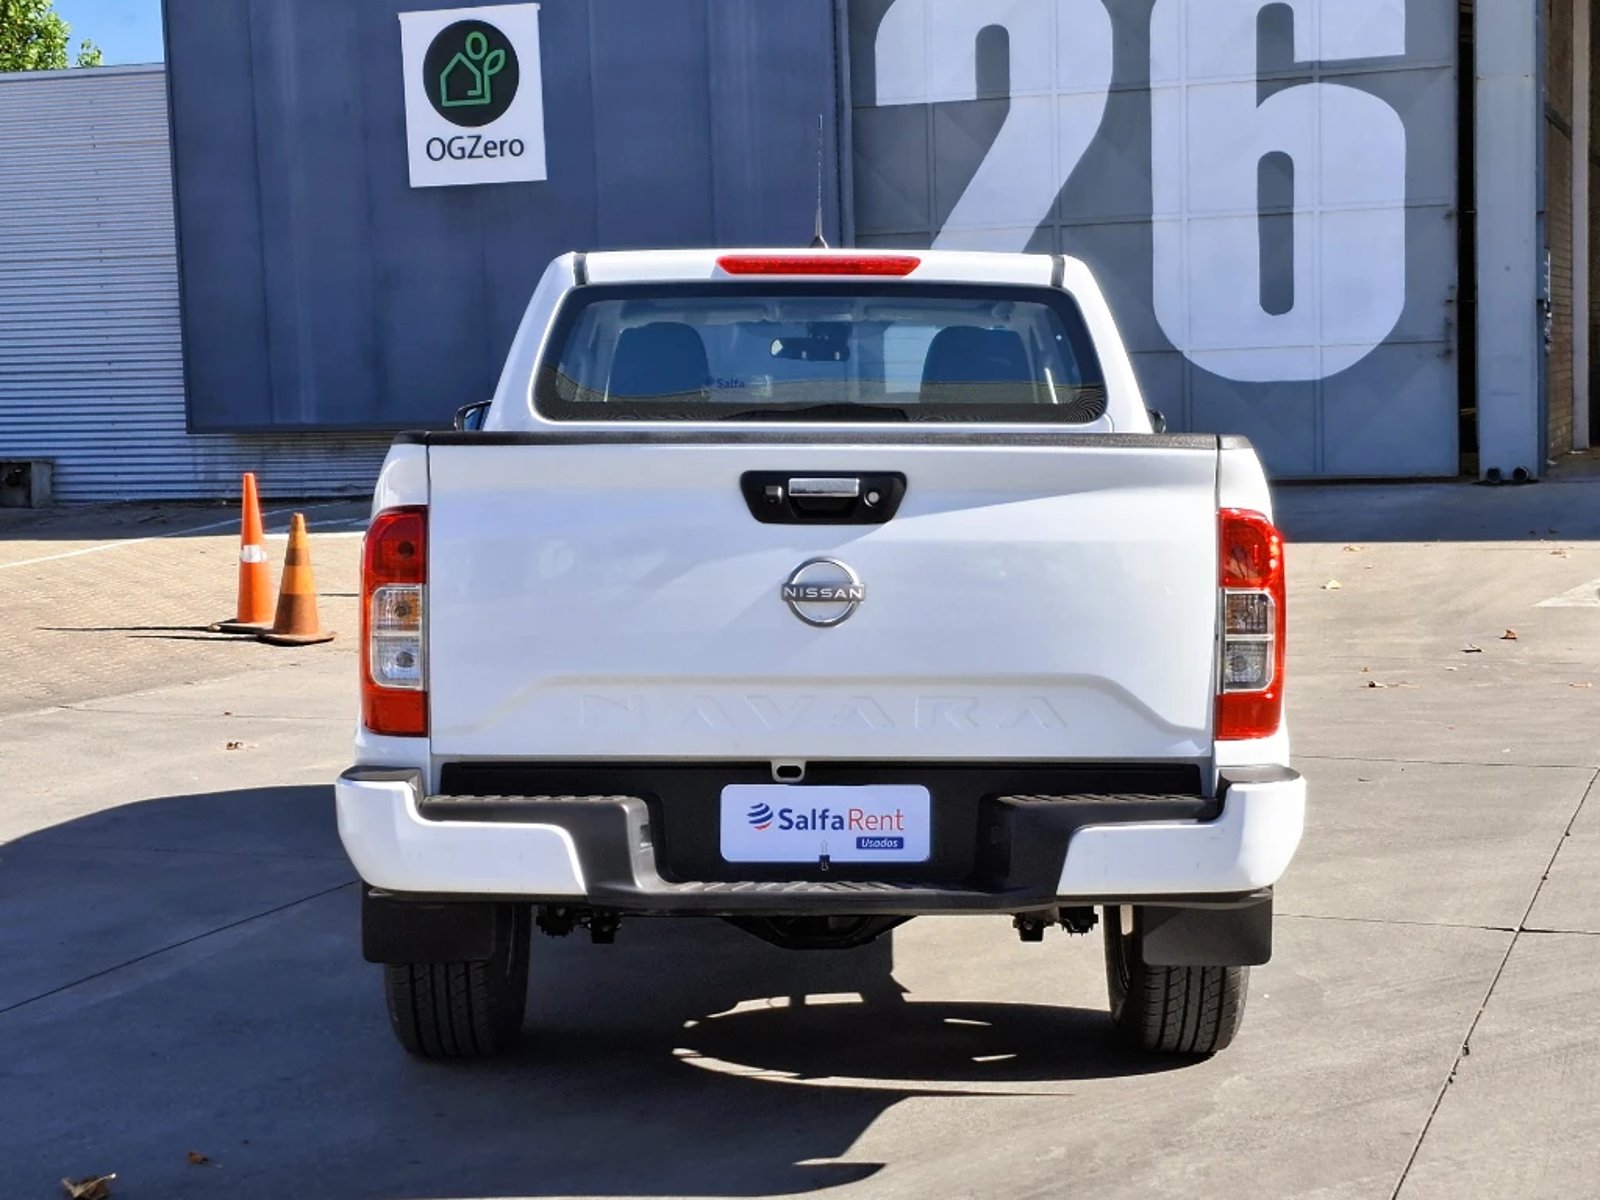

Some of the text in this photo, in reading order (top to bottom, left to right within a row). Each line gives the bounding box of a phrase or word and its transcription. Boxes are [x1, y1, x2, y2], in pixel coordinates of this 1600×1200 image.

[426, 134, 524, 161] OGZero
[874, 0, 1406, 382] 26
[783, 586, 862, 599] NISSAN
[578, 694, 1068, 730] NAVARA
[778, 807, 904, 831] SalfaRent
[861, 837, 899, 848] Usados
